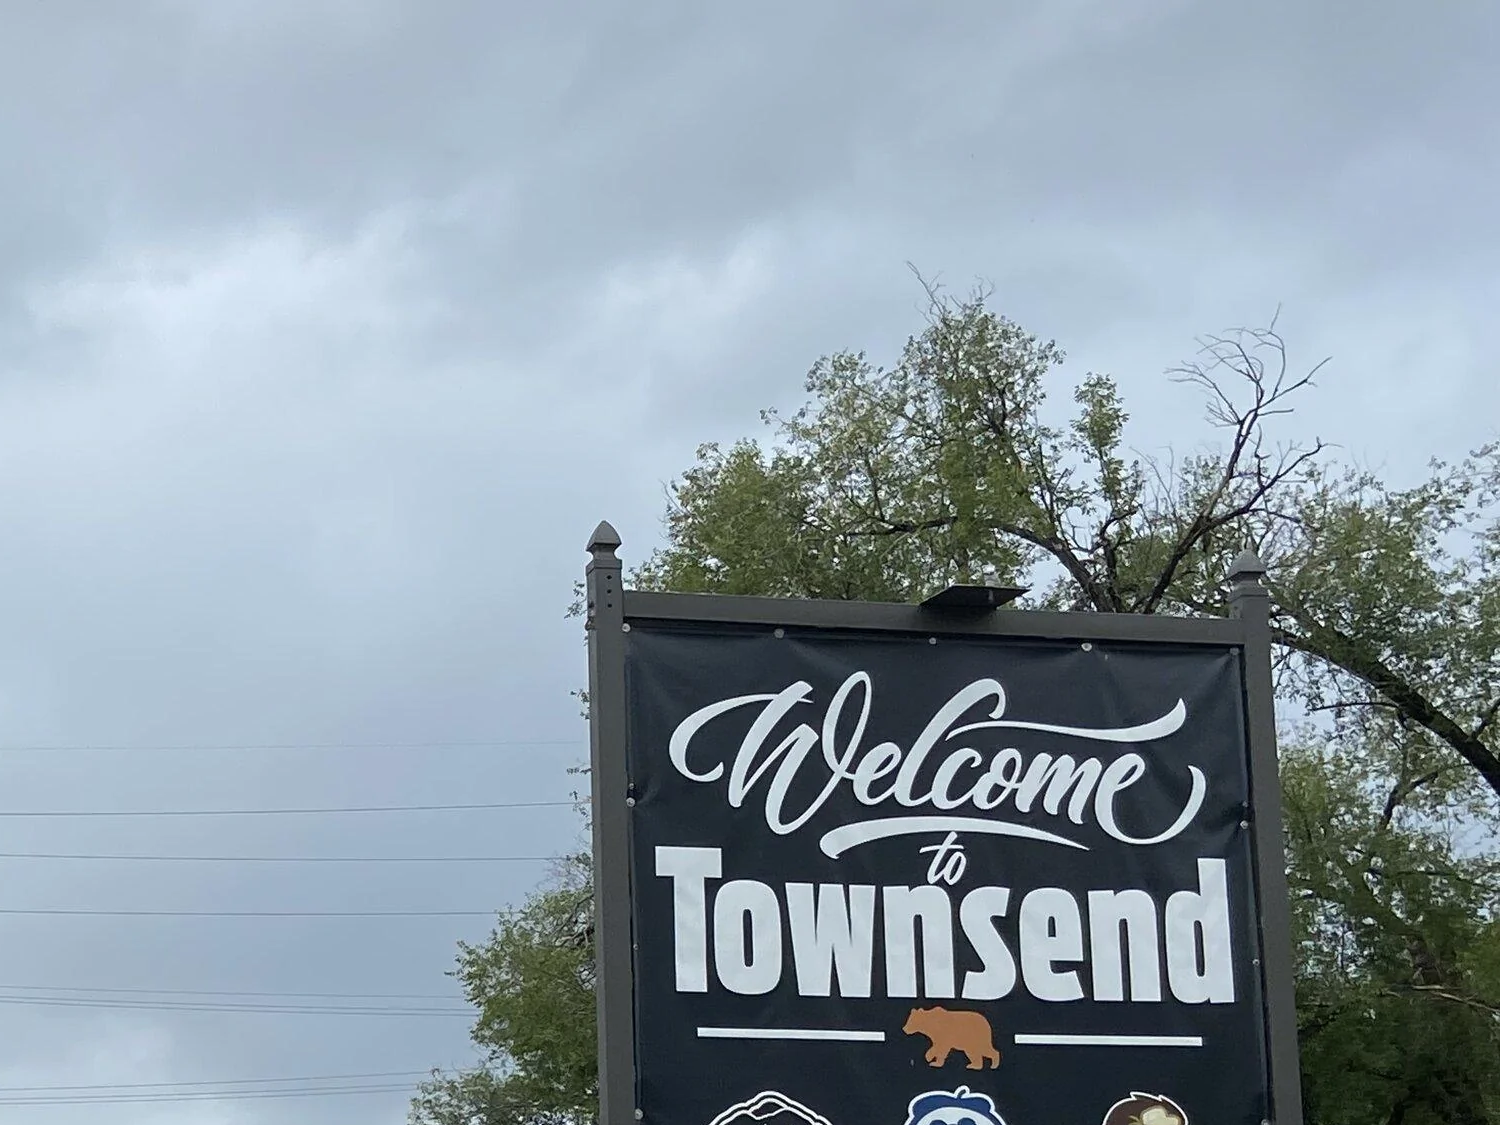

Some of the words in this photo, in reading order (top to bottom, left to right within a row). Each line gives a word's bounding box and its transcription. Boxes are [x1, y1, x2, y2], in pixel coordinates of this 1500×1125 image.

[668, 671, 1206, 845] Welcome
[655, 845, 1235, 1005] Townsend
[919, 831, 967, 886] to
